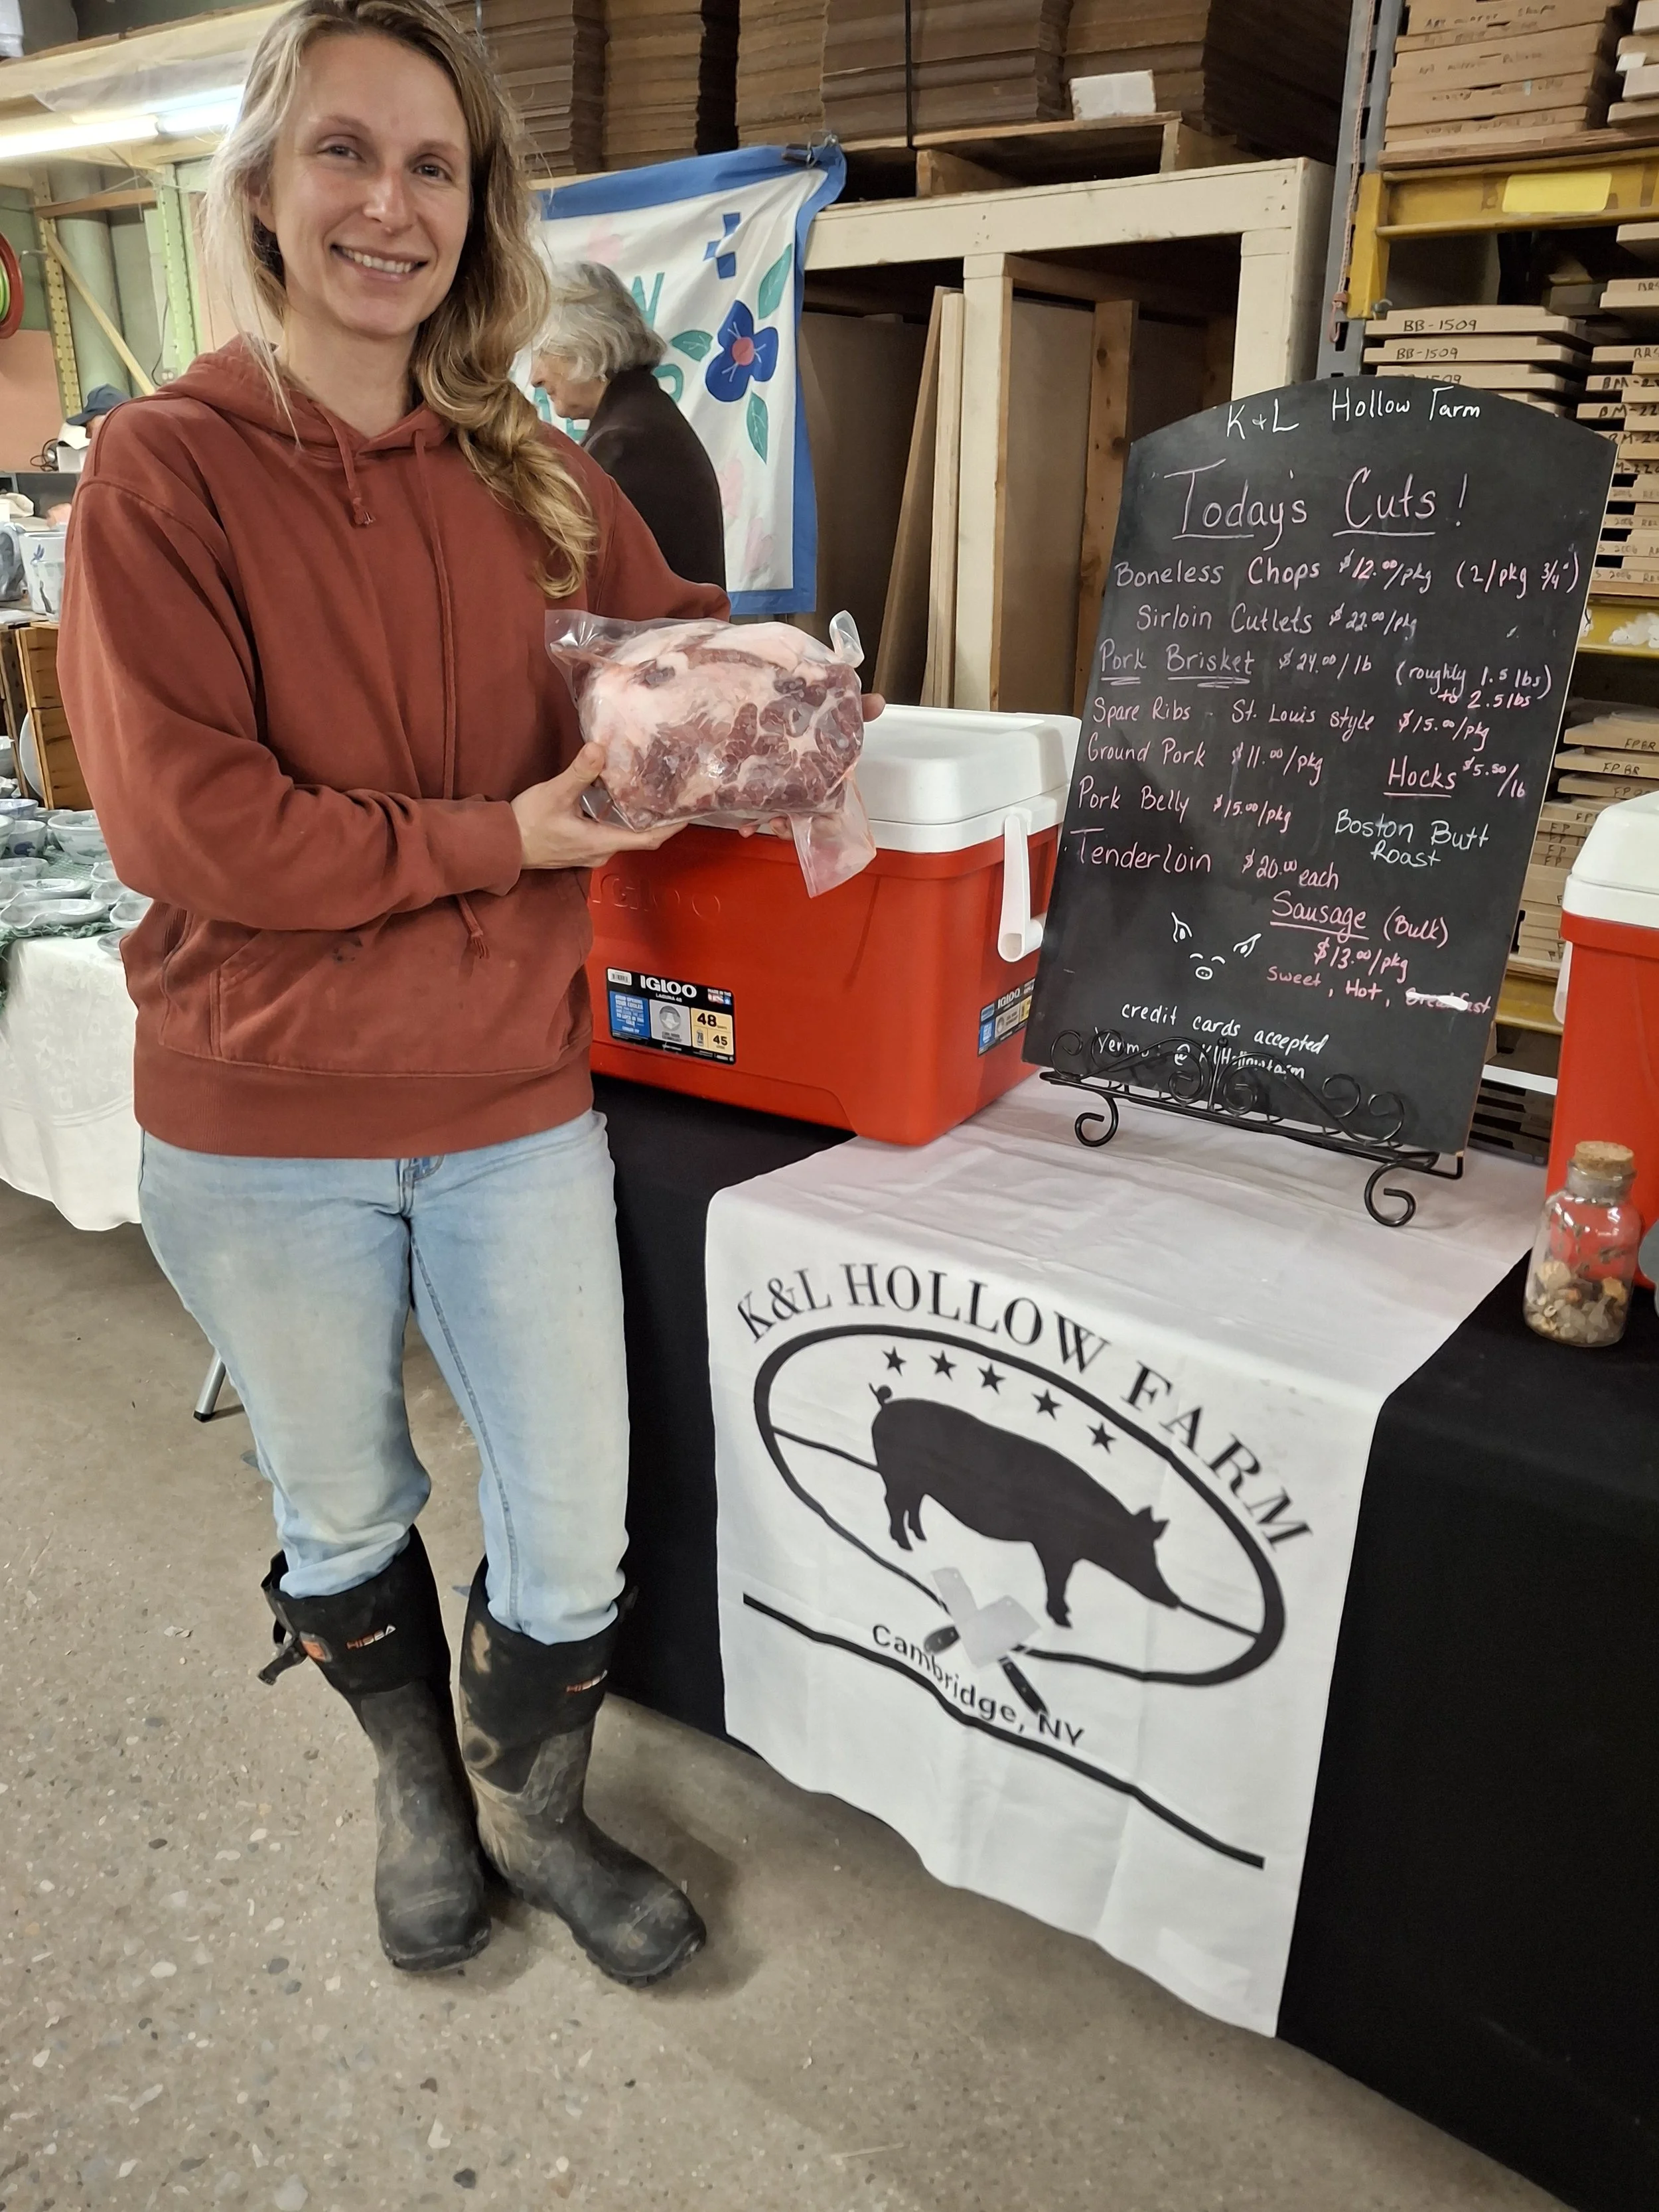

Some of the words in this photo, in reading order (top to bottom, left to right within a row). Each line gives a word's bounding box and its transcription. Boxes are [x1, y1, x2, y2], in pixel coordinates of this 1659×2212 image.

[1404, 319, 1477, 332] BB-1509
[1396, 347, 1459, 361] BB-1509
[1331, 386, 1411, 423] Hollow
[1163, 458, 1308, 552] Today's
[1114, 559, 1225, 587] Boneless
[1248, 555, 1321, 591] Chops
[1137, 603, 1212, 631] Sirloin
[1231, 602, 1313, 634] Cutlets
[1100, 638, 1147, 672] Pork
[1165, 643, 1256, 675] Brisket
[1396, 660, 1466, 697] (roughly
[1092, 697, 1140, 728] Spare
[1153, 696, 1192, 720] Ribs
[1232, 699, 1258, 723] St.
[1268, 703, 1317, 723] Louis
[1329, 706, 1376, 742] style
[1088, 732, 1151, 763] Ground
[1161, 737, 1206, 768] Pork
[1388, 755, 1457, 790] Hocks
[1078, 775, 1121, 810] Pork
[1140, 785, 1190, 824] Belly
[1334, 809, 1415, 844] Boston
[1431, 820, 1490, 850] Butt
[1070, 828, 1212, 874] Tenderloin
[1299, 862, 1339, 891] each
[1370, 840, 1442, 867] Roast
[1271, 890, 1367, 943] Sausage
[1383, 905, 1449, 949] (Bulk)
[640, 974, 697, 998] IGLOO
[697, 1012, 717, 1027] 48
[1121, 1003, 1178, 1025] credit
[1192, 1015, 1242, 1037] cards
[1254, 1029, 1330, 1056] accepted
[713, 1035, 728, 1047] 45
[737, 1268, 832, 1343] K&L
[840, 1262, 1112, 1374] HOLLOW
[1120, 1359, 1314, 1552] FARM
[872, 1623, 1026, 1733] Cambridge,
[1038, 1712, 1086, 1747] NY
